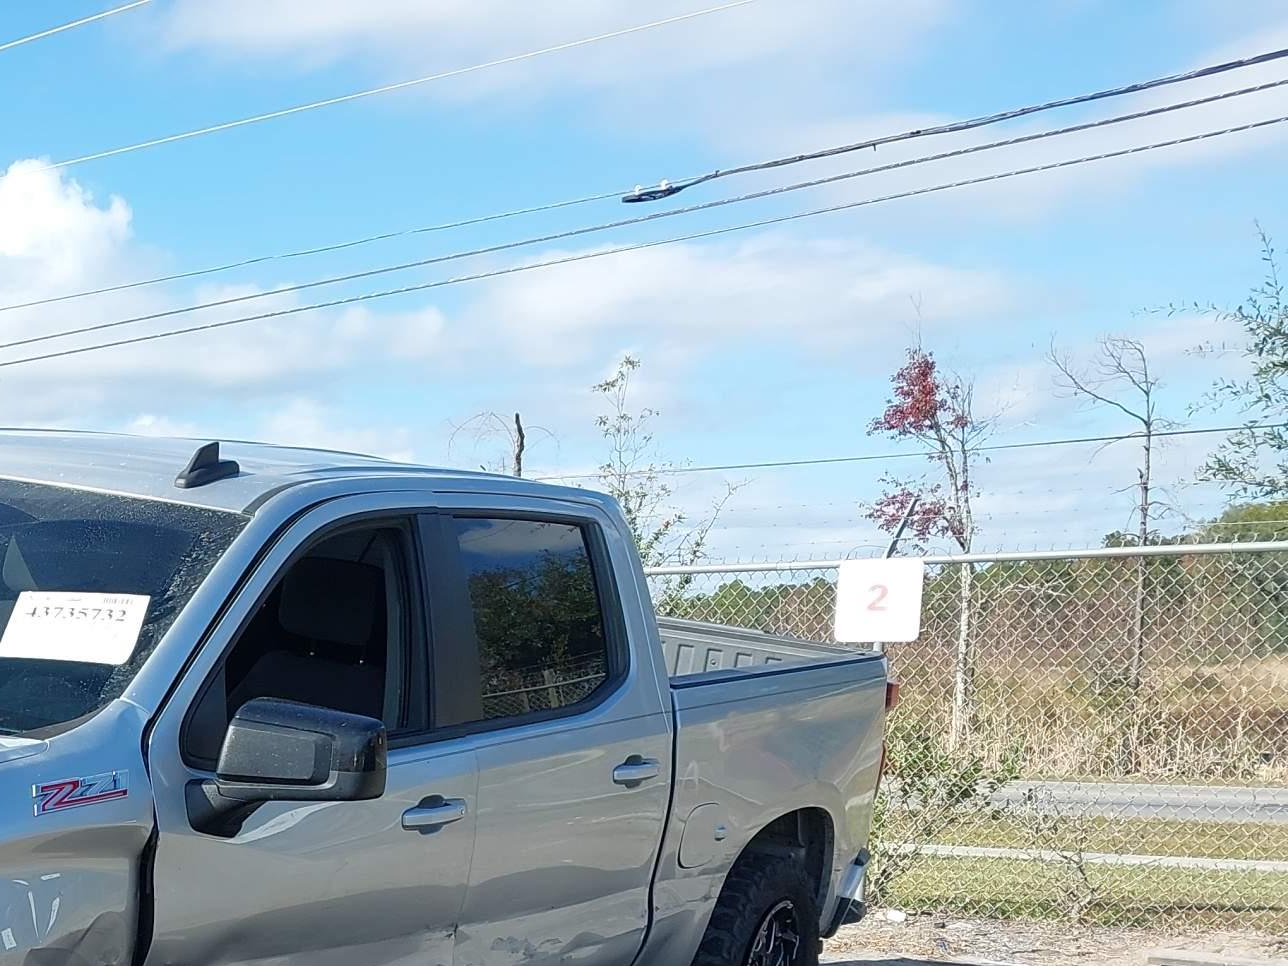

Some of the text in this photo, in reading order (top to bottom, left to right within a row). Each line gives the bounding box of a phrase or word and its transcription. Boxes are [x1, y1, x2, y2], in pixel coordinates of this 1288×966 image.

[865, 583, 889, 612] 2
[24, 605, 128, 623] 43735732
[32, 769, 129, 817] Z71
